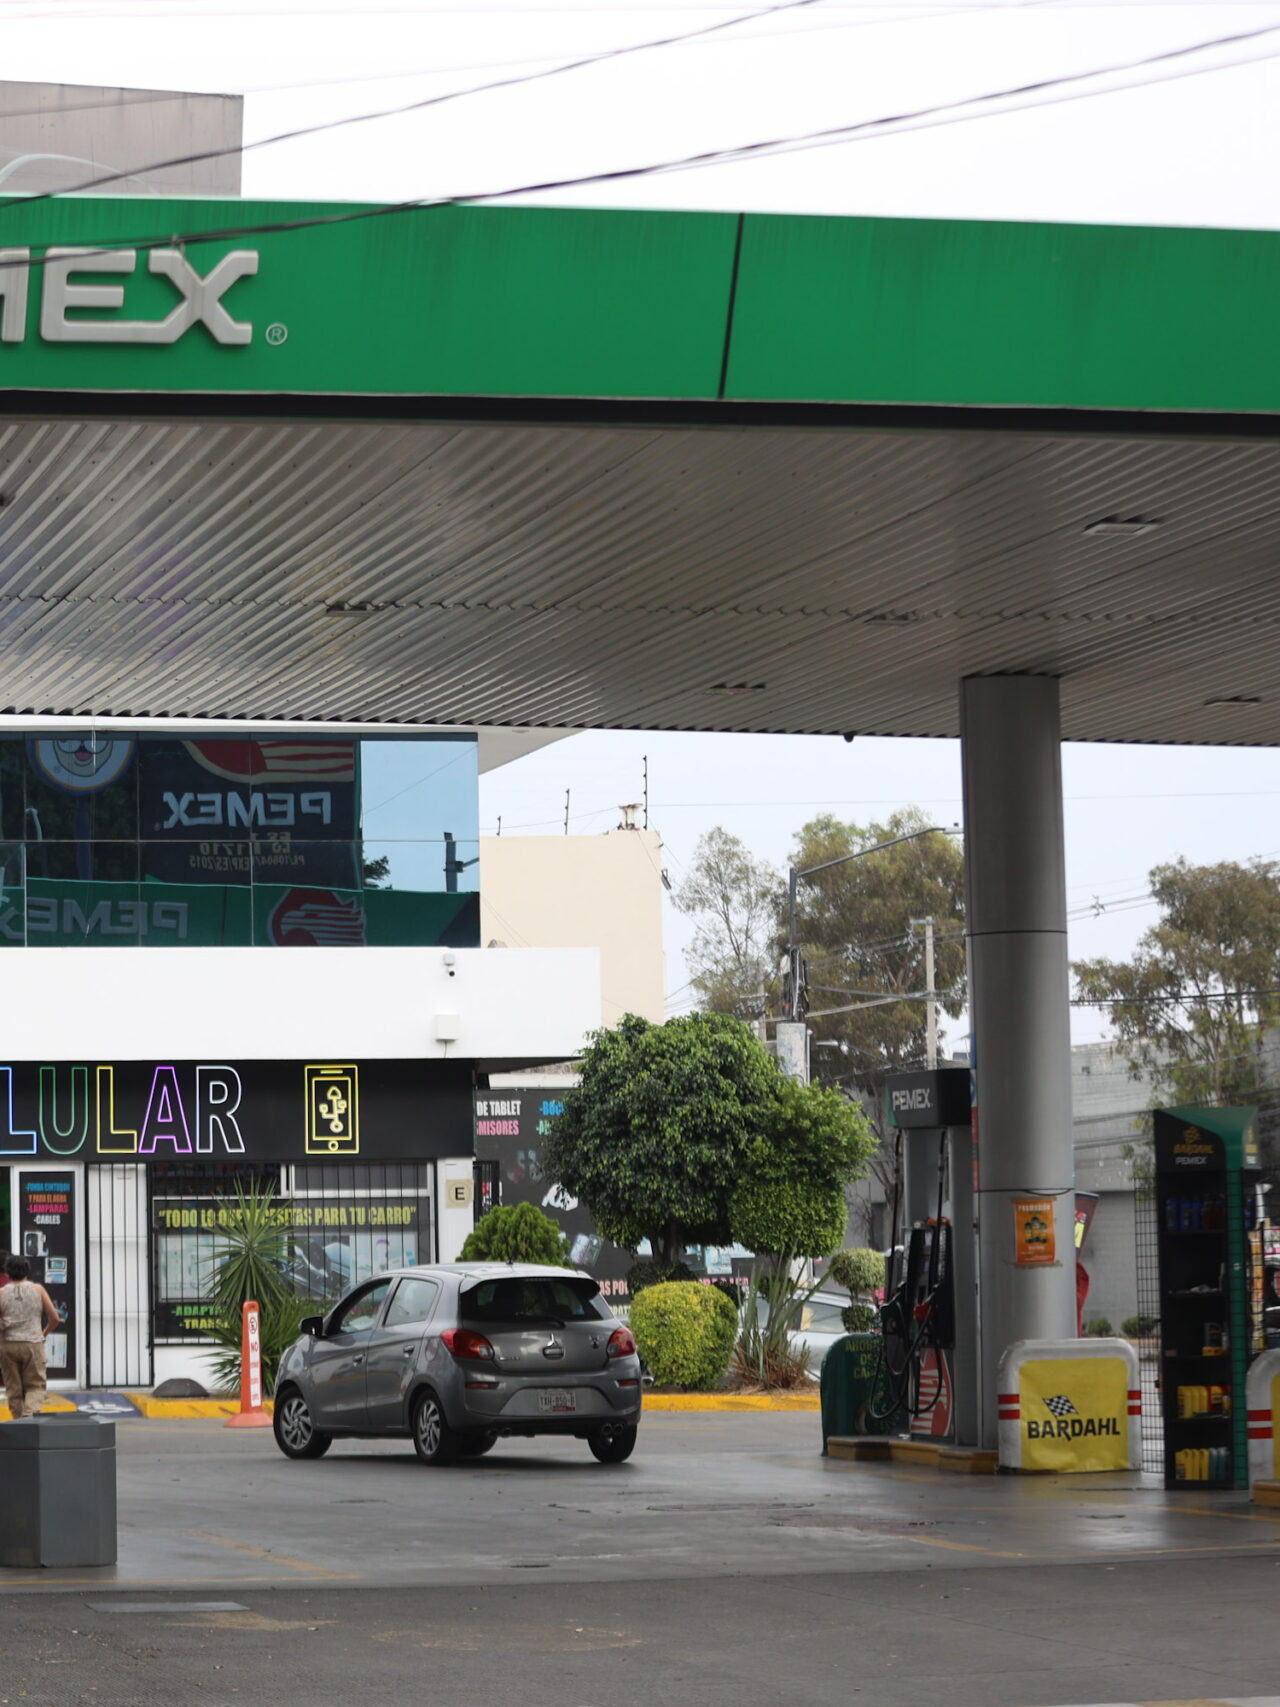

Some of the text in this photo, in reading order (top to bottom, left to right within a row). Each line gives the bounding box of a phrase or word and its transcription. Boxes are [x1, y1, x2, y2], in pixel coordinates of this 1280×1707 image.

[490, 1100, 521, 1116] TABLET
[892, 1088, 931, 1111] PEMEX
[455, 1187, 465, 1201] E
[315, 1208, 348, 1226] PARA
[349, 1207, 366, 1226] TU
[1027, 1418, 1120, 1441] BARDAHL
